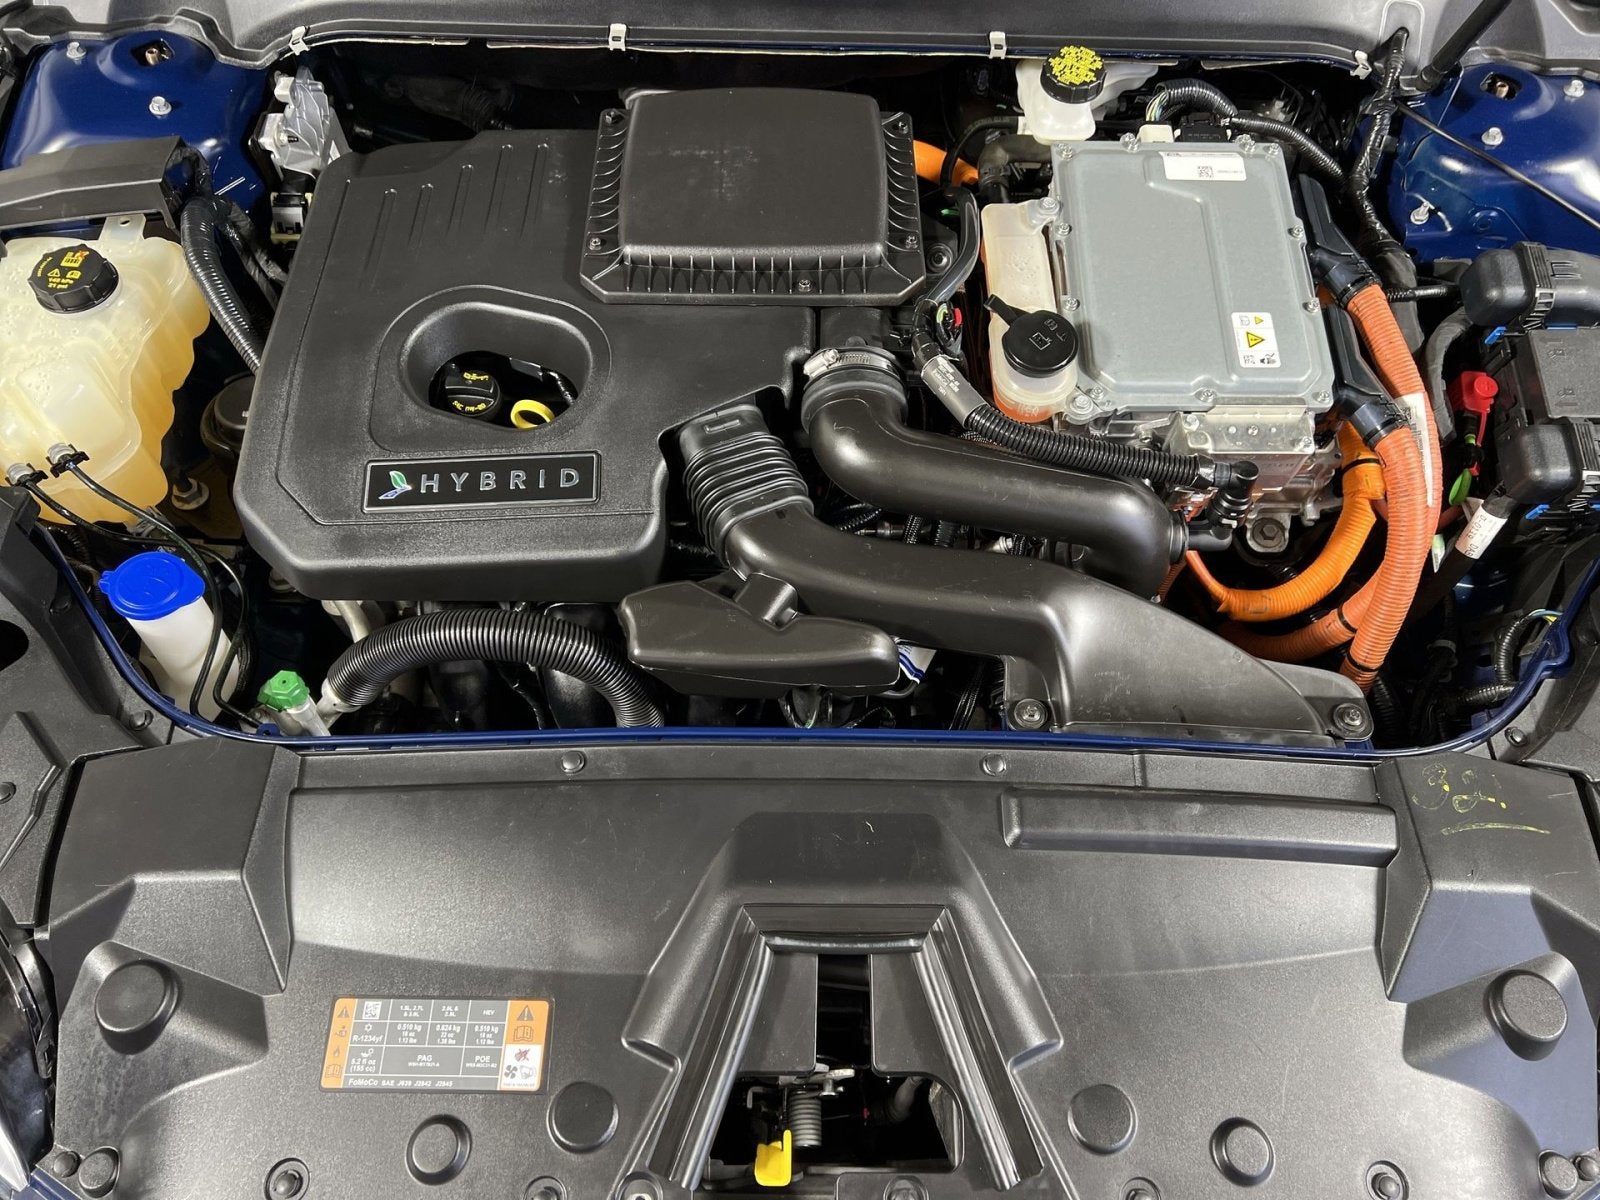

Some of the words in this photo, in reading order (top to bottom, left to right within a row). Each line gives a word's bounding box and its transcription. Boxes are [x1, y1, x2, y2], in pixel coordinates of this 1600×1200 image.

[420, 468, 580, 493] HYBRID
[414, 1024, 422, 1032] kg
[453, 1025, 461, 1033] kg
[491, 1025, 498, 1034] kg
[352, 1035, 383, 1043] R-1234yf
[348, 1078, 378, 1086] FoMoCo
